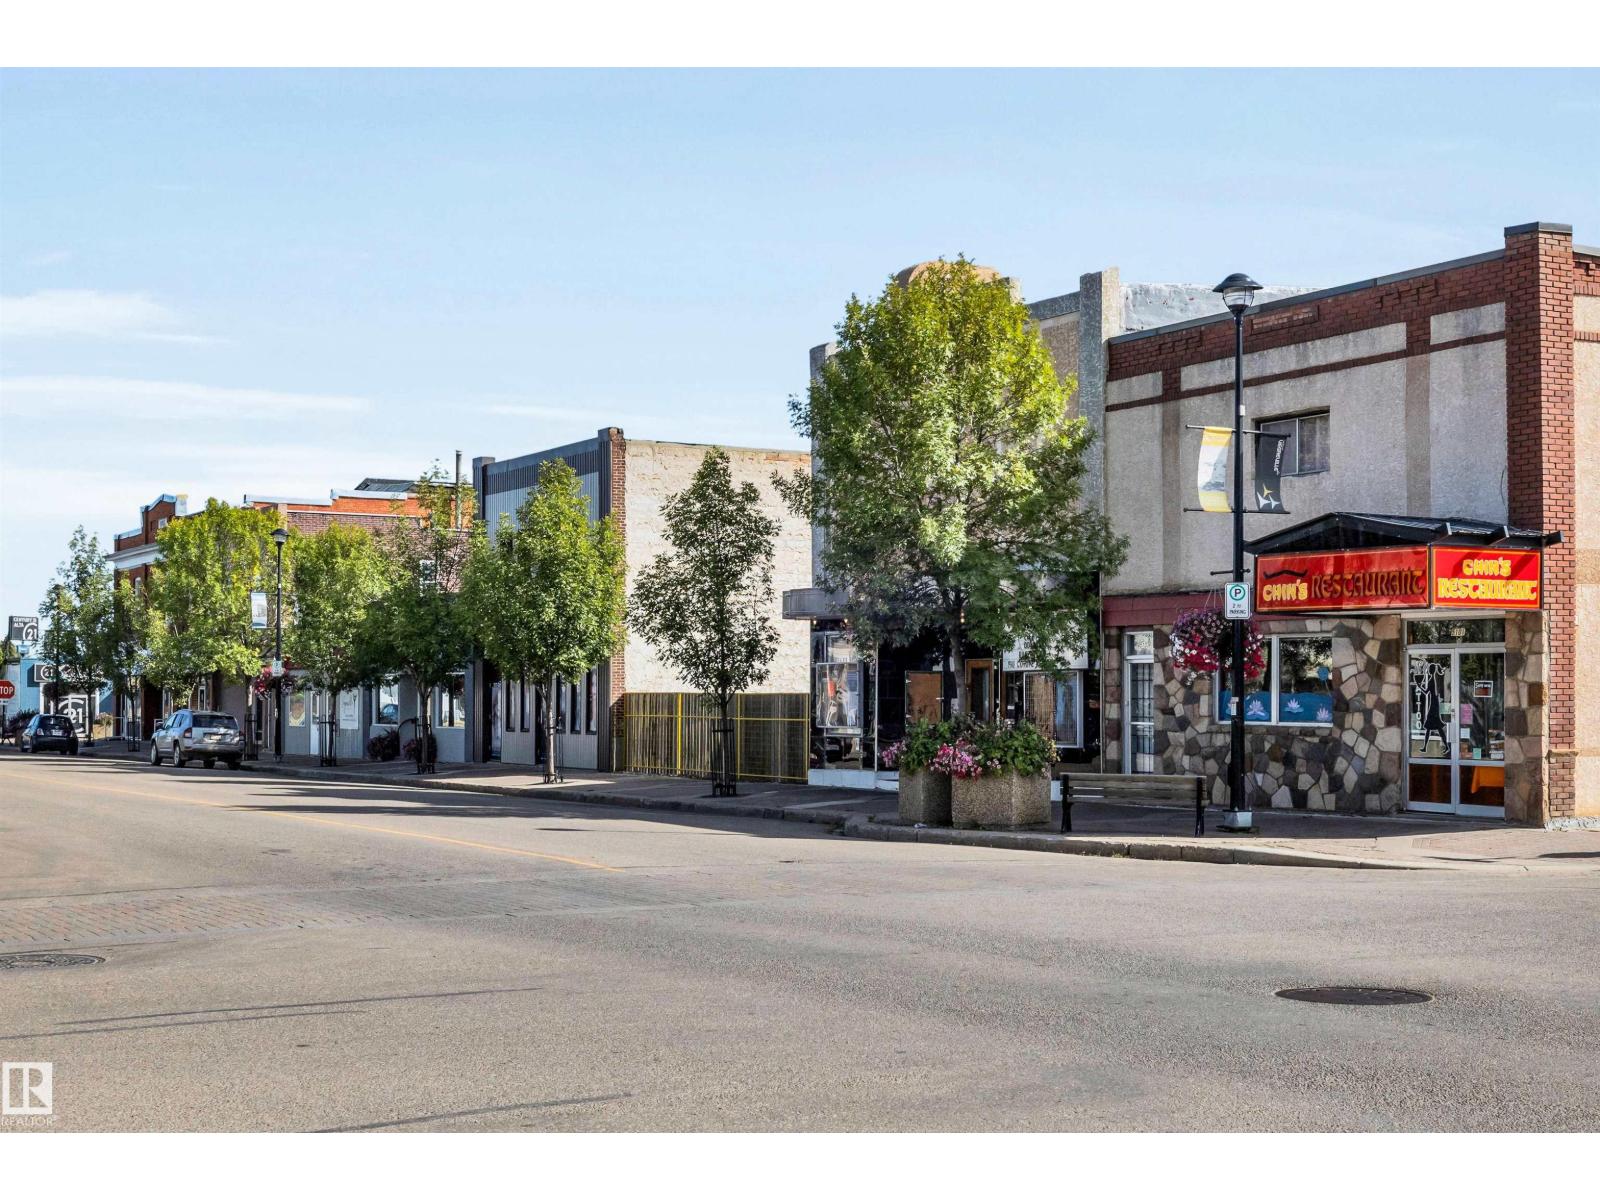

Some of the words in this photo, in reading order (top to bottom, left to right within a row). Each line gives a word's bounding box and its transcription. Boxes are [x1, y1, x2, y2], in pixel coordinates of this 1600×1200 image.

[1462, 557, 1511, 577] CHIN'S
[1262, 579, 1308, 601] CHIN'S
[1311, 570, 1424, 599] RESTAURANT
[1437, 577, 1538, 600] RESTAURANT
[0, 686, 14, 695] TOP
